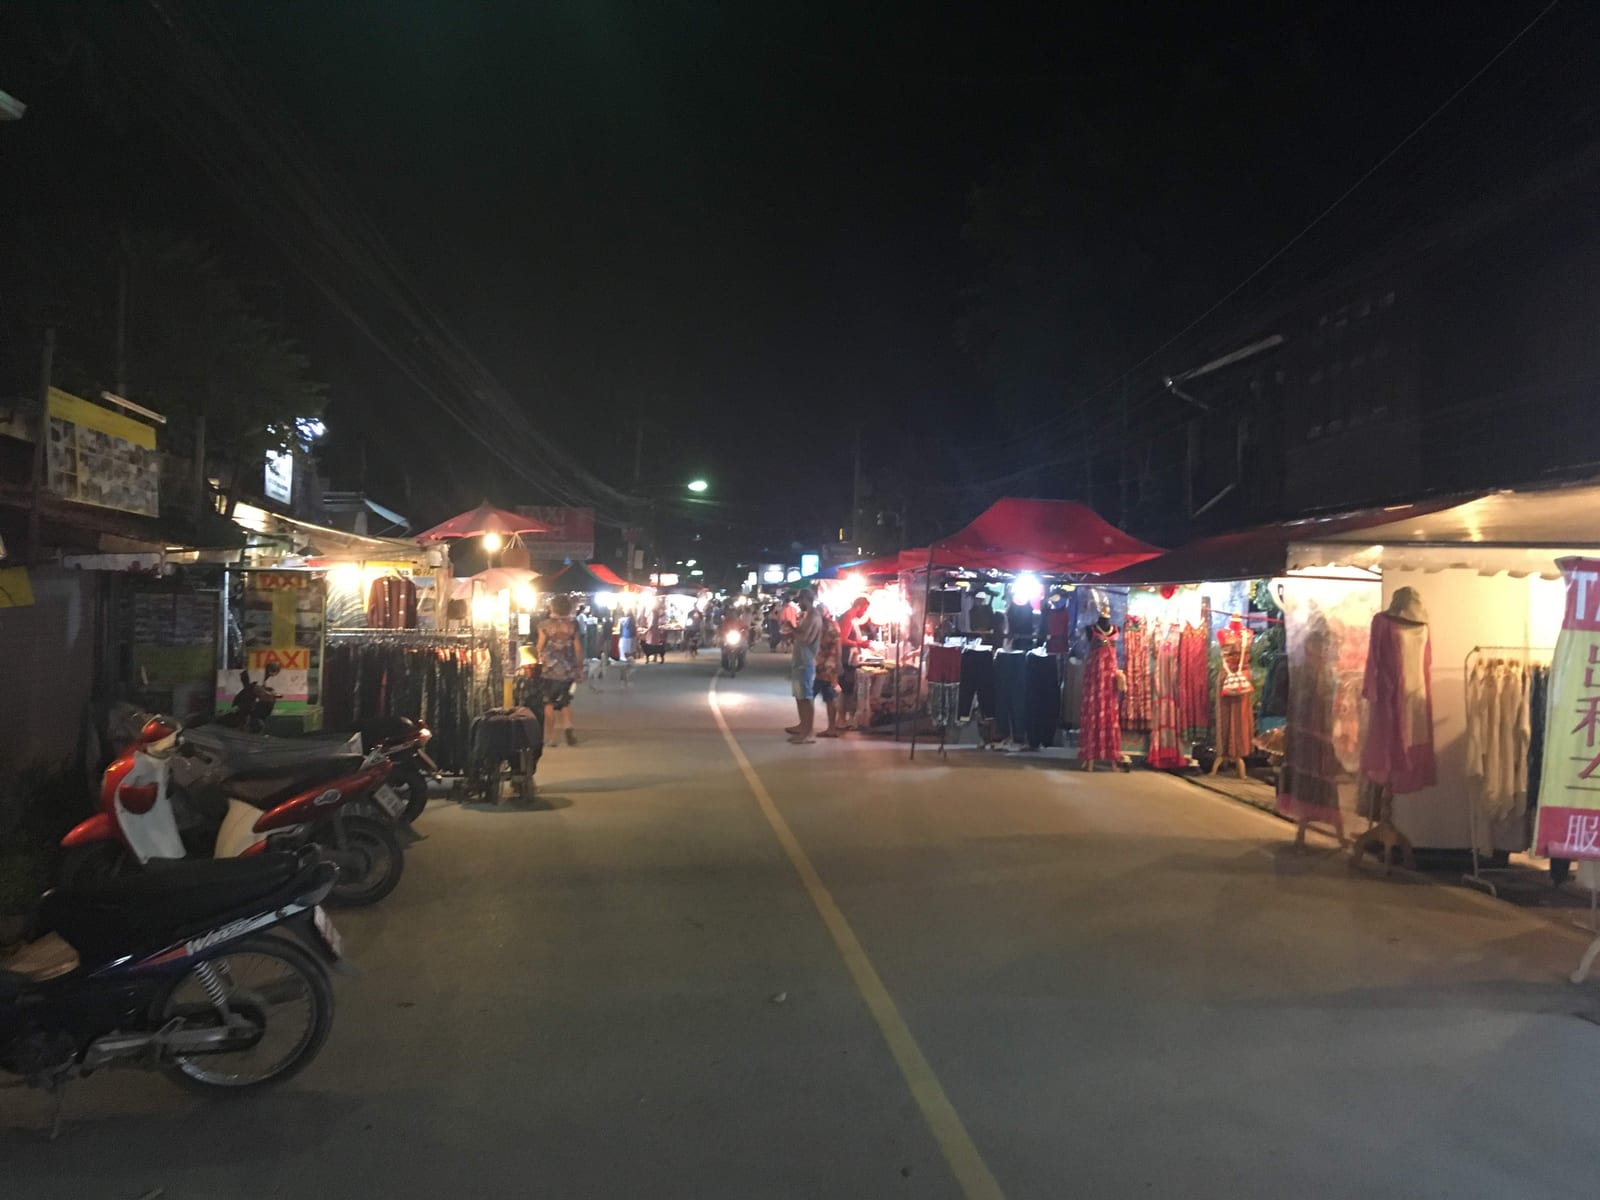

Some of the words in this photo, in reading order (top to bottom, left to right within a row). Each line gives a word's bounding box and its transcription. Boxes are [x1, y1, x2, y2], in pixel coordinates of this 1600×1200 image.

[259, 573, 304, 588] TAXI
[1571, 570, 1600, 622] T
[250, 650, 308, 669] TAXI
